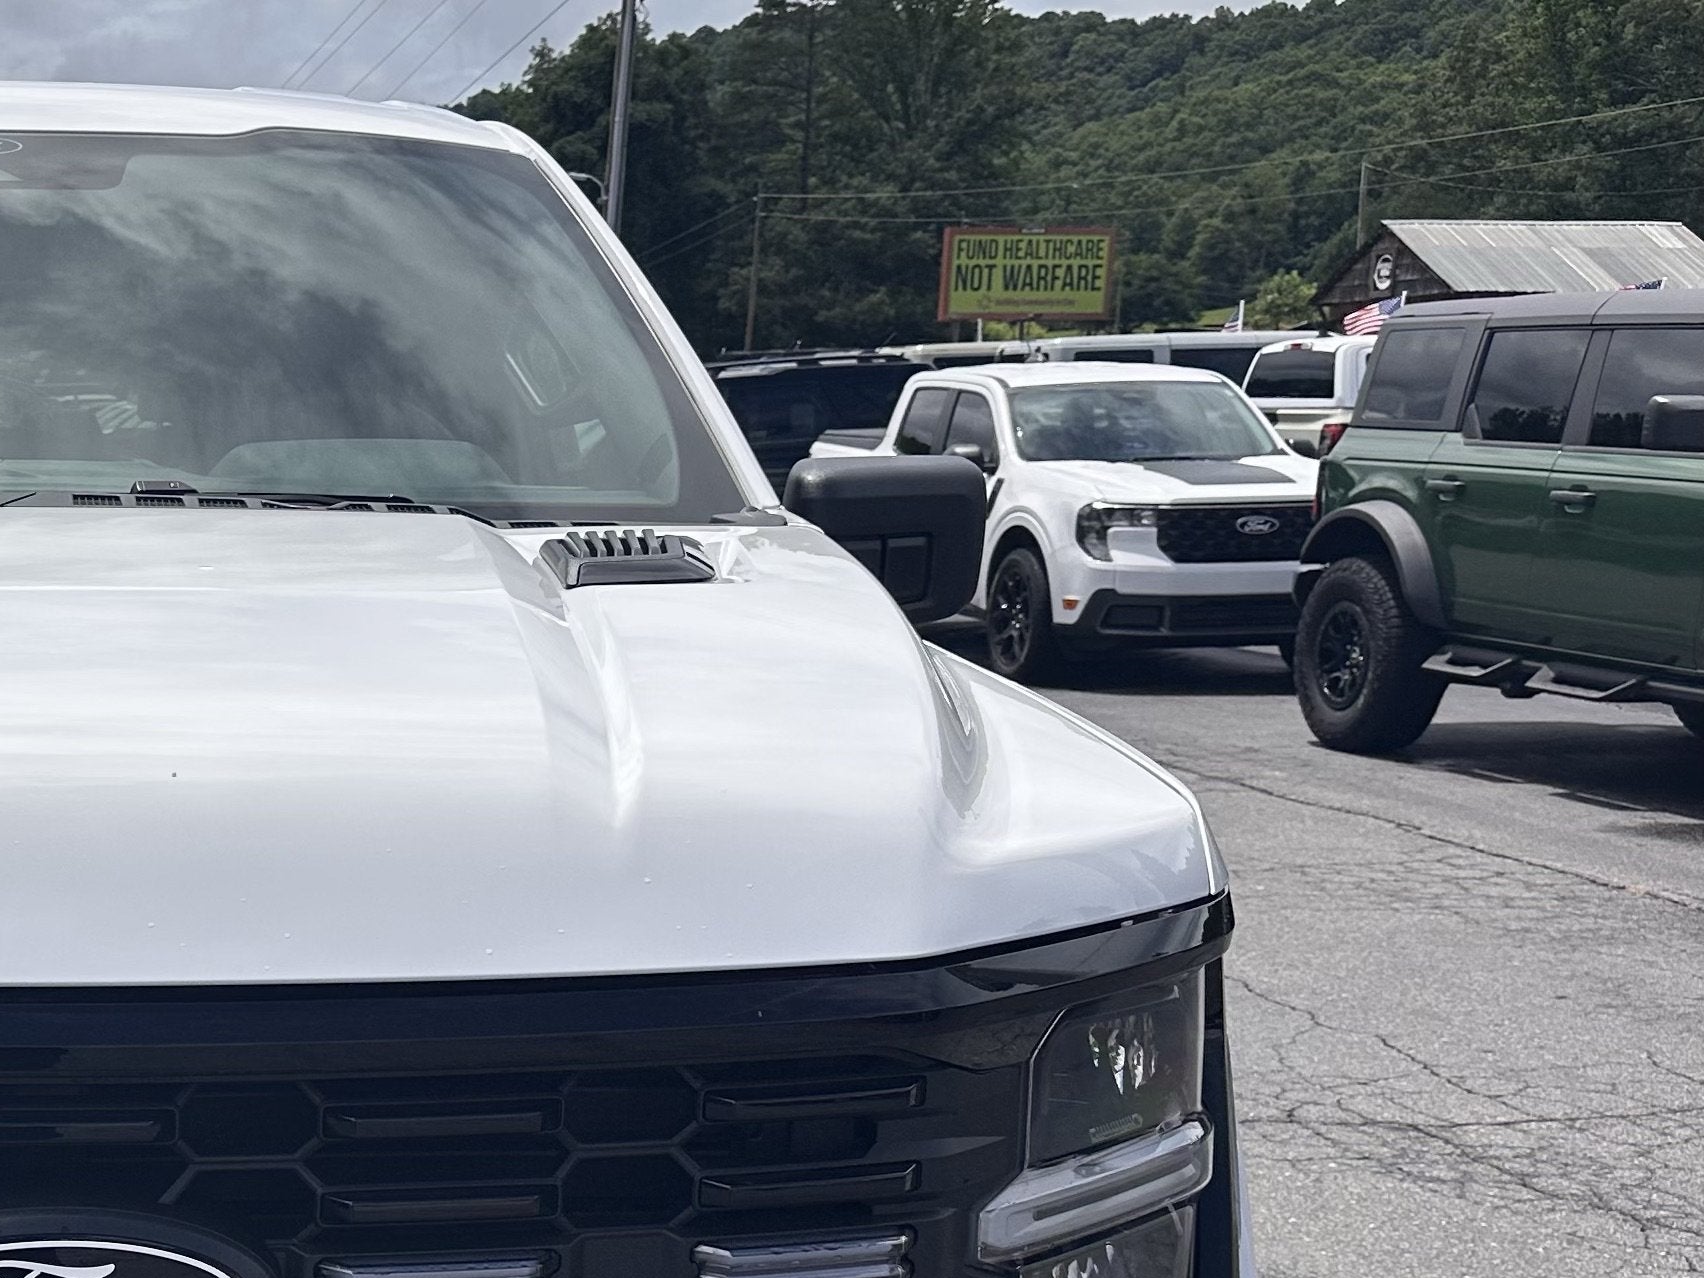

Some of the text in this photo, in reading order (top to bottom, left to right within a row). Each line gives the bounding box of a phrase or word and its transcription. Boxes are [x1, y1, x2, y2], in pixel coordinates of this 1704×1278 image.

[956, 238, 1105, 260] FUND HEALTHCARE
[954, 264, 1104, 291] NOT WARFARE
